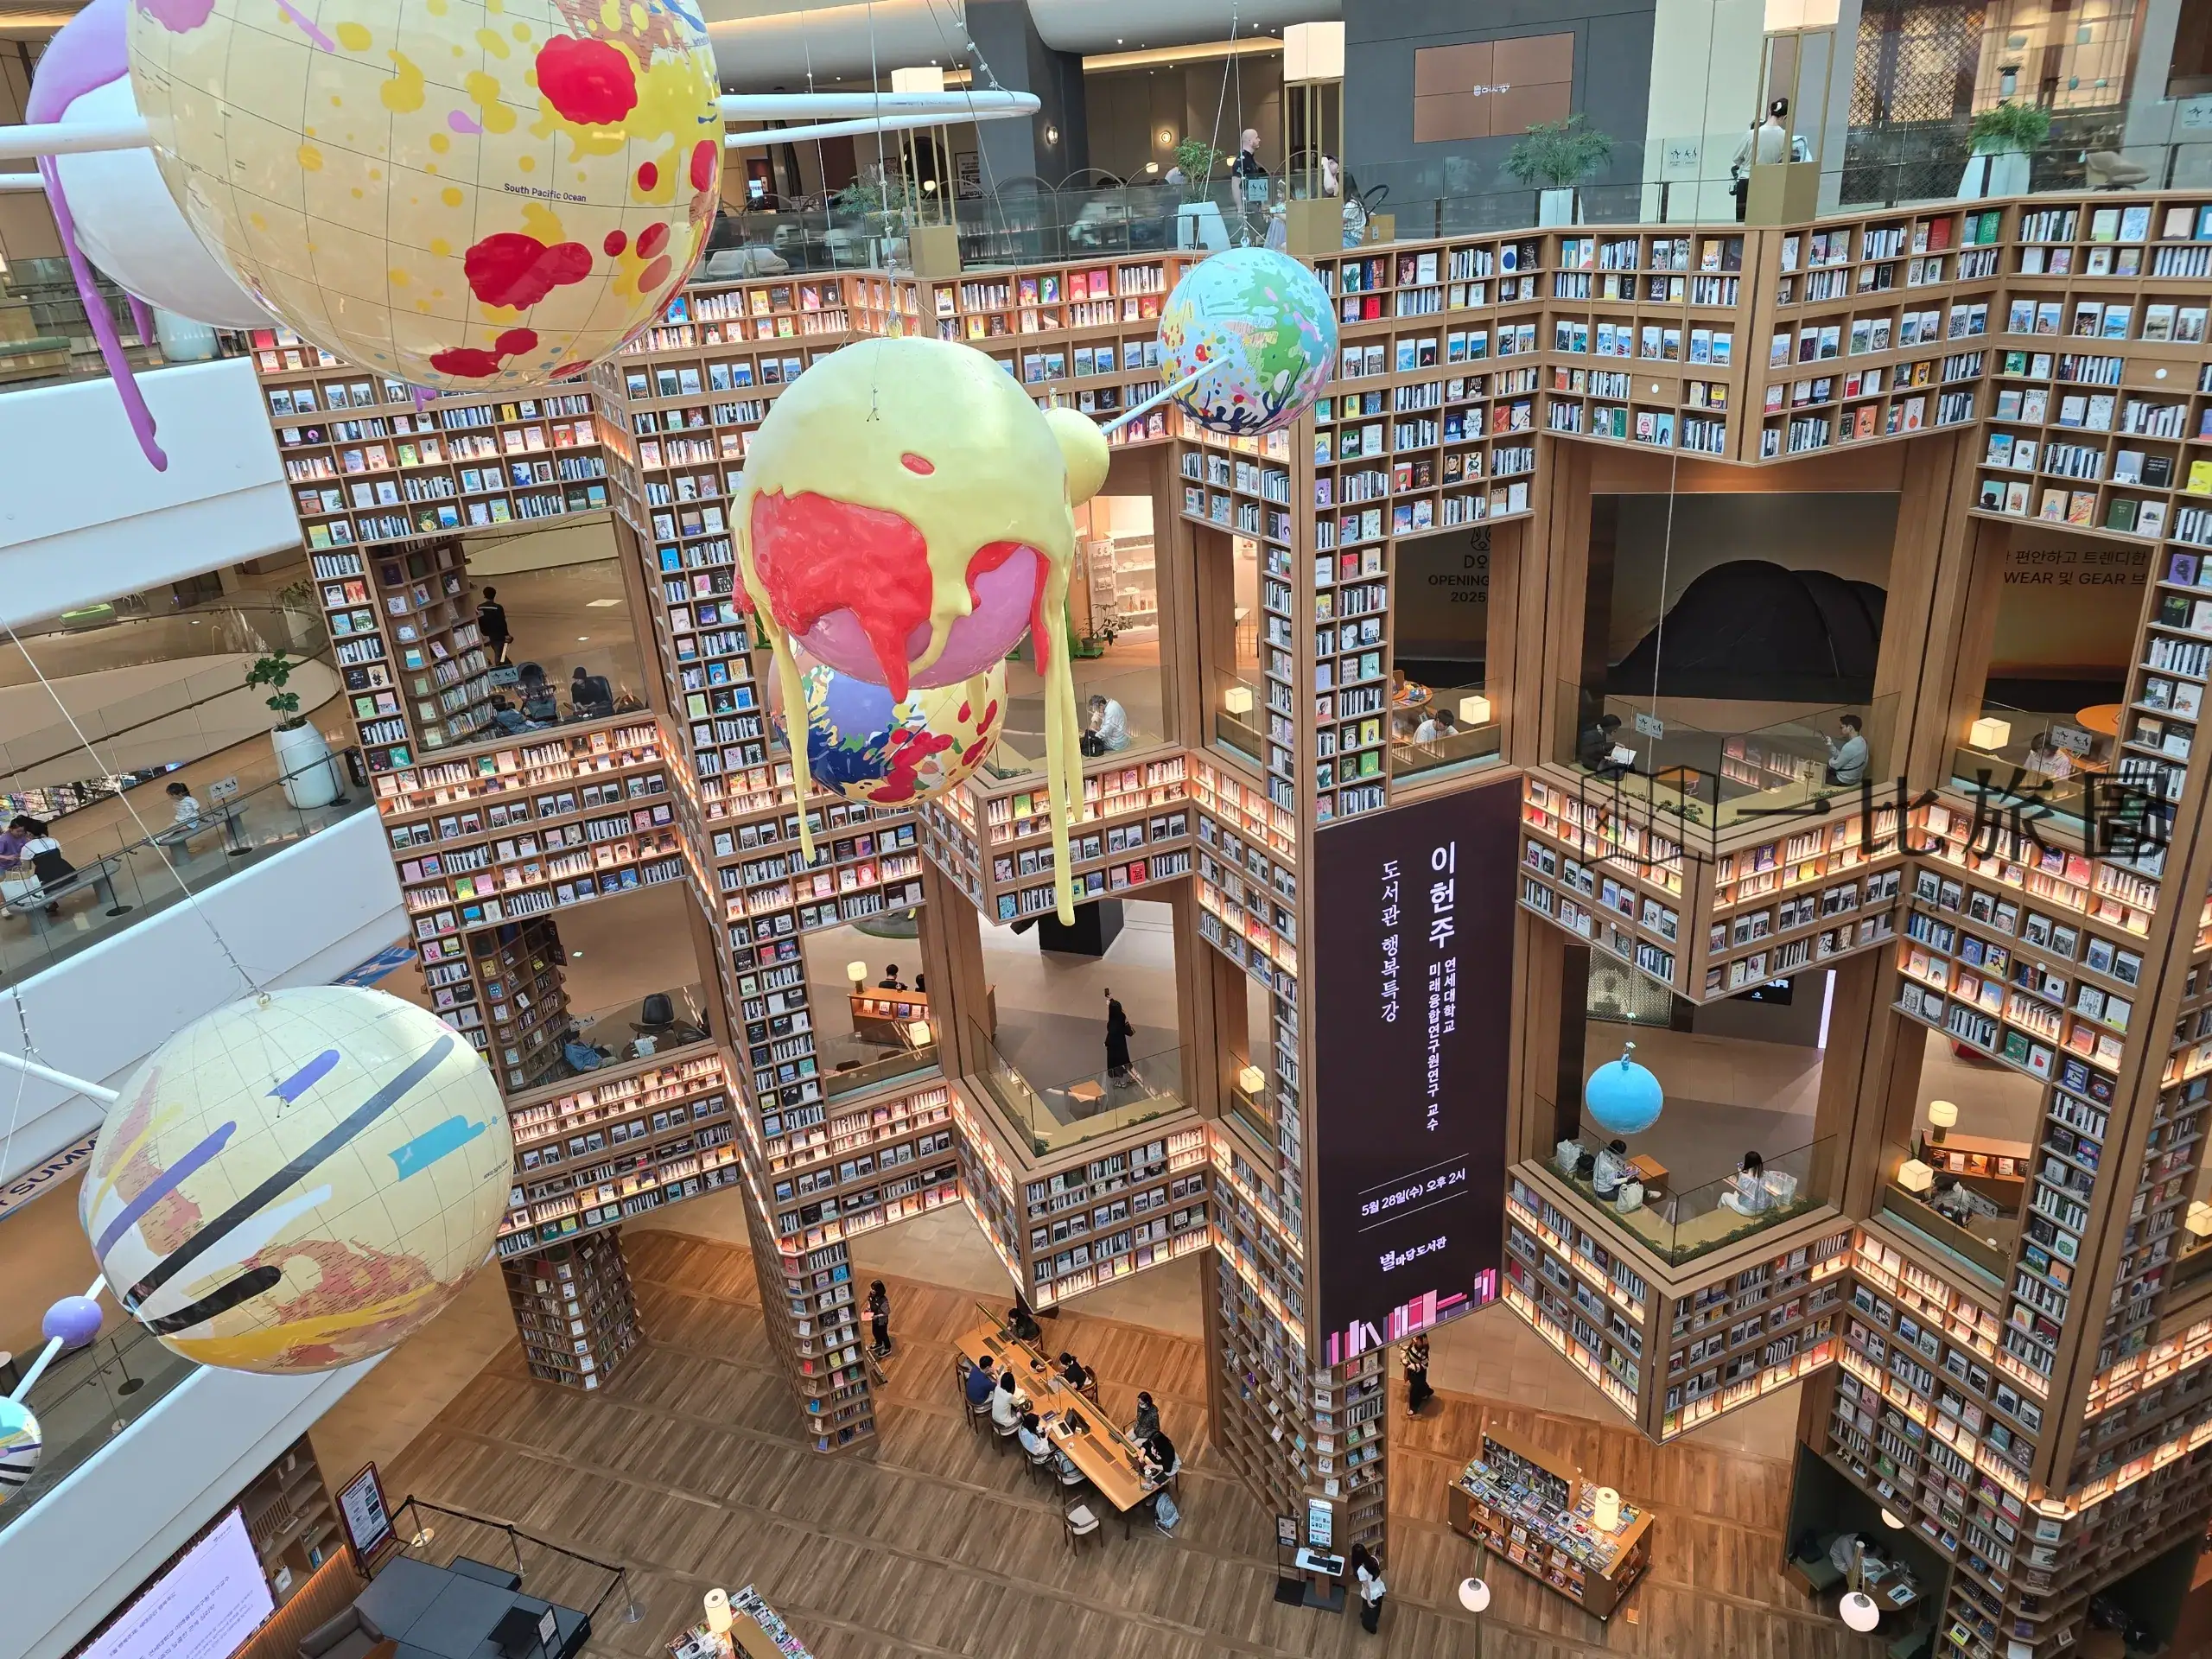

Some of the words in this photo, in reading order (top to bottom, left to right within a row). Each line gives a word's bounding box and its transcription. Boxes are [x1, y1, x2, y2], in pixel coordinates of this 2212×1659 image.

[504, 183, 530, 195] South
[531, 188, 562, 200] Pacific
[563, 192, 587, 202] Ocean
[2016, 550, 2078, 564] 편안하고
[2082, 550, 2147, 566] 트렌디한
[2004, 571, 2054, 585] WEAR
[2059, 571, 2074, 586] 및
[2079, 572, 2126, 585] GEAR
[1450, 591, 1487, 603] 2025
[1381, 860, 1401, 927] 도서관
[1428, 841, 1455, 949] 이헌주
[1381, 934, 1400, 1023] 행복특강
[1443, 957, 1456, 1034] 연세대학교
[1427, 1103, 1440, 1131] 교수
[1361, 1199, 1379, 1217] 5월
[1381, 1184, 1424, 1210] 28일(수)
[1426, 1175, 1446, 1192] 오후
[1448, 1167, 1465, 1185] 2시
[1379, 1236, 1447, 1272] 별마당도서관
